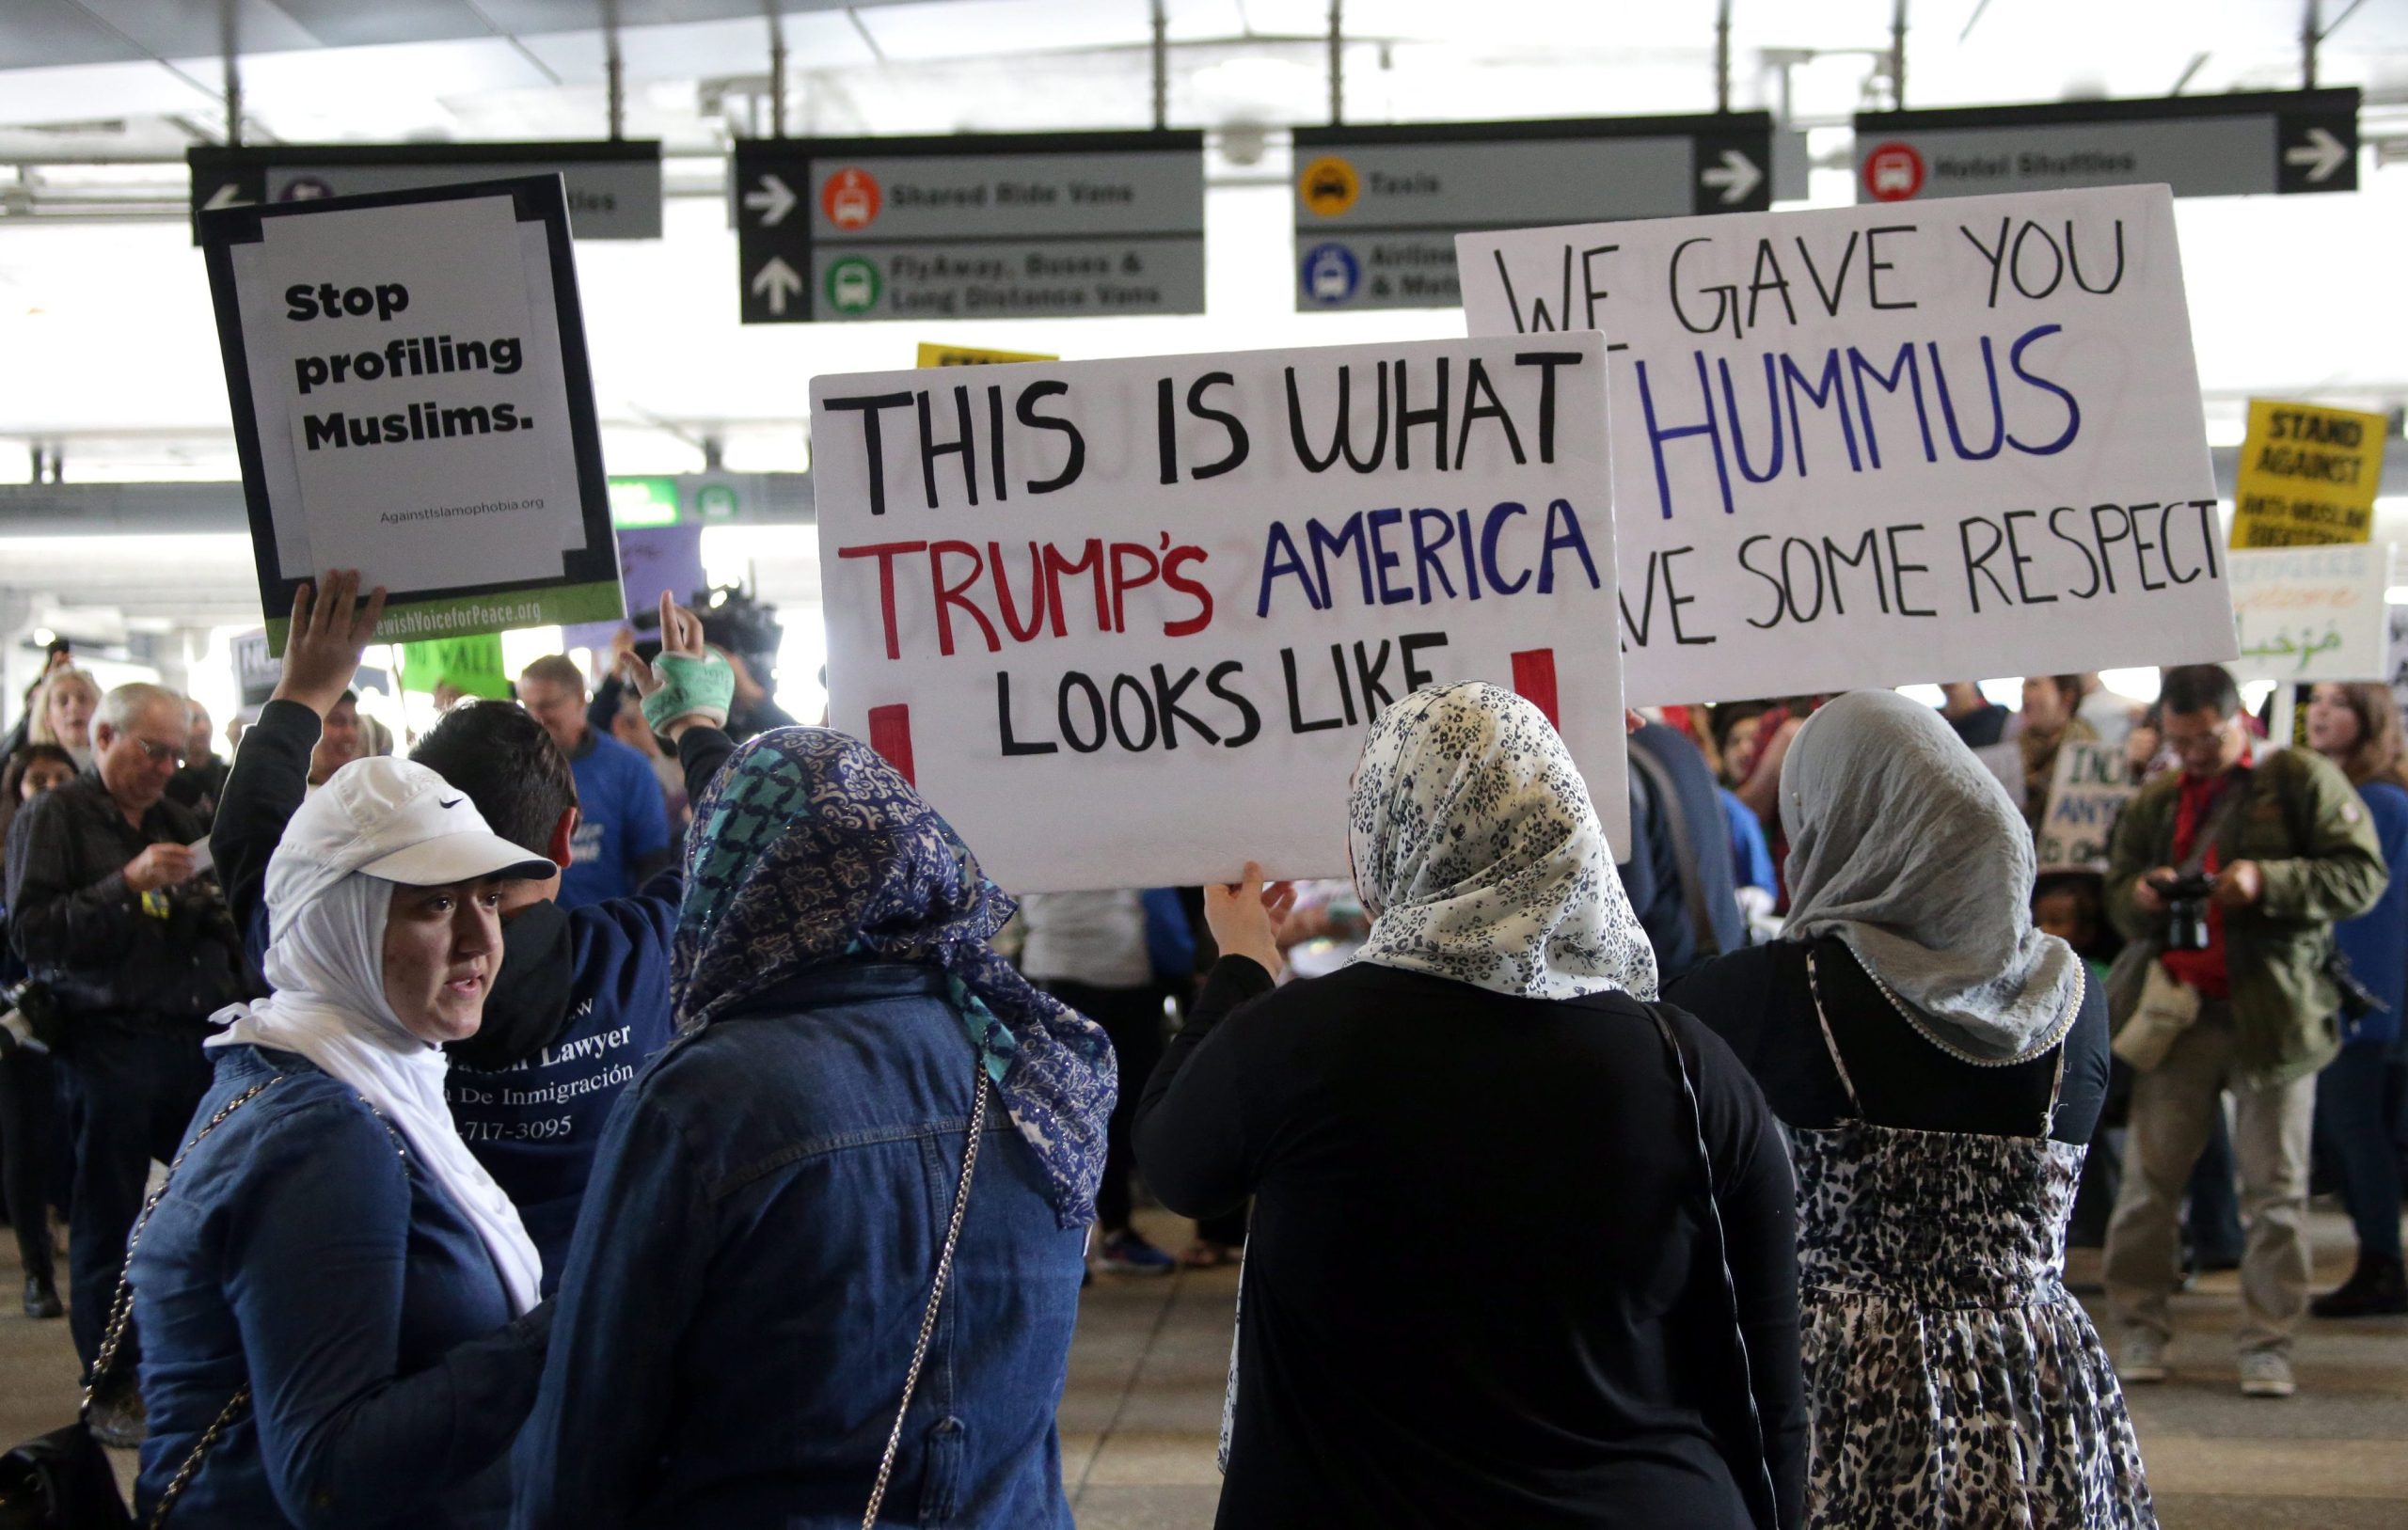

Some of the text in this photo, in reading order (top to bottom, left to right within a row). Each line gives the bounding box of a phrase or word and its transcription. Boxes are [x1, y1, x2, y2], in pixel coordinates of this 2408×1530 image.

[1934, 150, 2135, 179] Hotel Shuttles
[890, 181, 1134, 209] Shared Ride Vans
[1025, 252, 1110, 276] Buses
[1121, 250, 1144, 276] &
[1670, 225, 1918, 339] GAVE
[1960, 216, 2125, 308] YOU
[284, 282, 409, 322] Stop
[890, 281, 1162, 315] Long Distance Vans
[294, 335, 523, 394] profiling
[302, 402, 533, 451] Muslims.
[822, 352, 1583, 515] THIS IS WHAT
[1635, 323, 2082, 520] HUMMUS
[2268, 410, 2363, 448] STAND
[2256, 445, 2362, 487] AGAINST
[380, 497, 545, 524] AgainstIslamophobia.org
[837, 498, 1601, 660] TRUMP'S AMERICA
[1618, 498, 2218, 653] VE SOME RESPECT
[373, 602, 542, 637] ewishVoiceforPeace.org
[997, 660, 1261, 756] LOOKS
[540, 1025, 631, 1067] Lawyer
[461, 1087, 494, 1105] De
[503, 1064, 634, 1105] Inmigración
